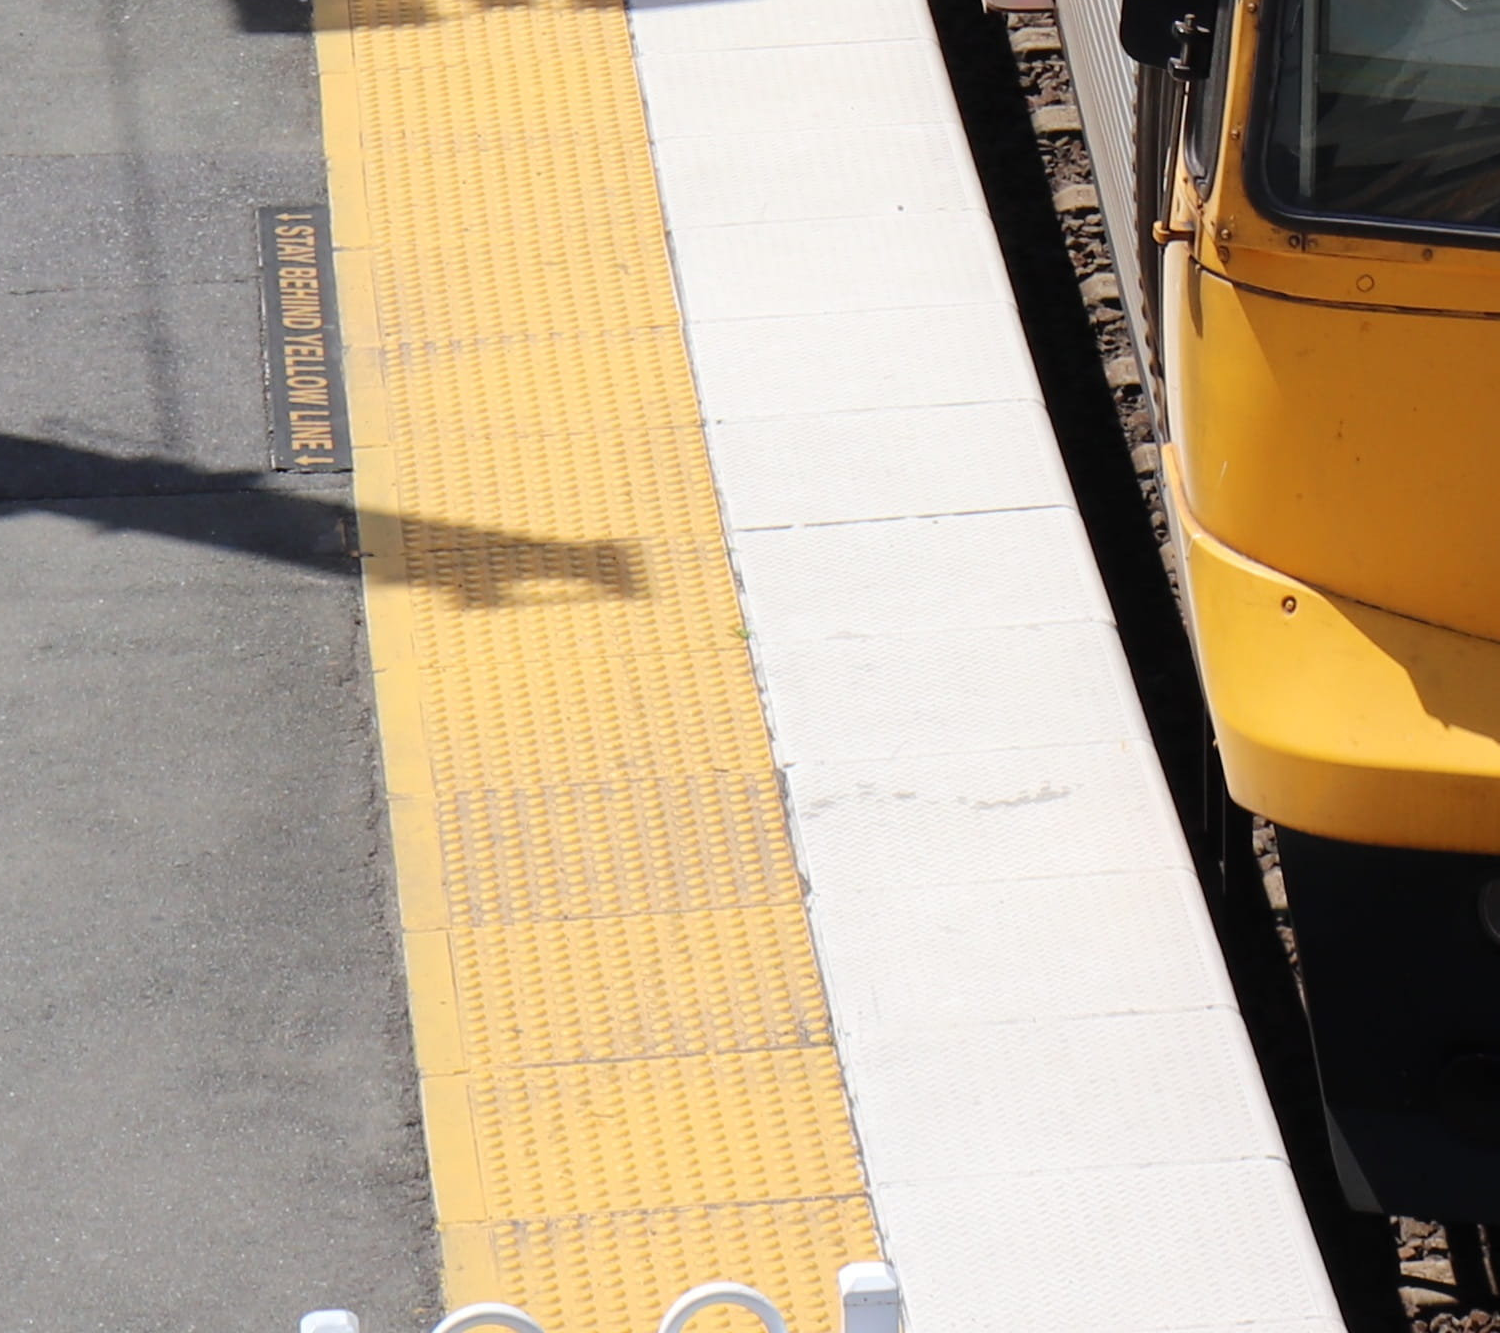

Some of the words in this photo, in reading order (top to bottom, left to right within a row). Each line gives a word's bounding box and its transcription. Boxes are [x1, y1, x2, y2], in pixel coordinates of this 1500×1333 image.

[275, 225, 316, 264] STAY
[278, 267, 323, 330] BEHIND
[283, 334, 329, 406] YELLOW
[289, 410, 334, 451] LINE
